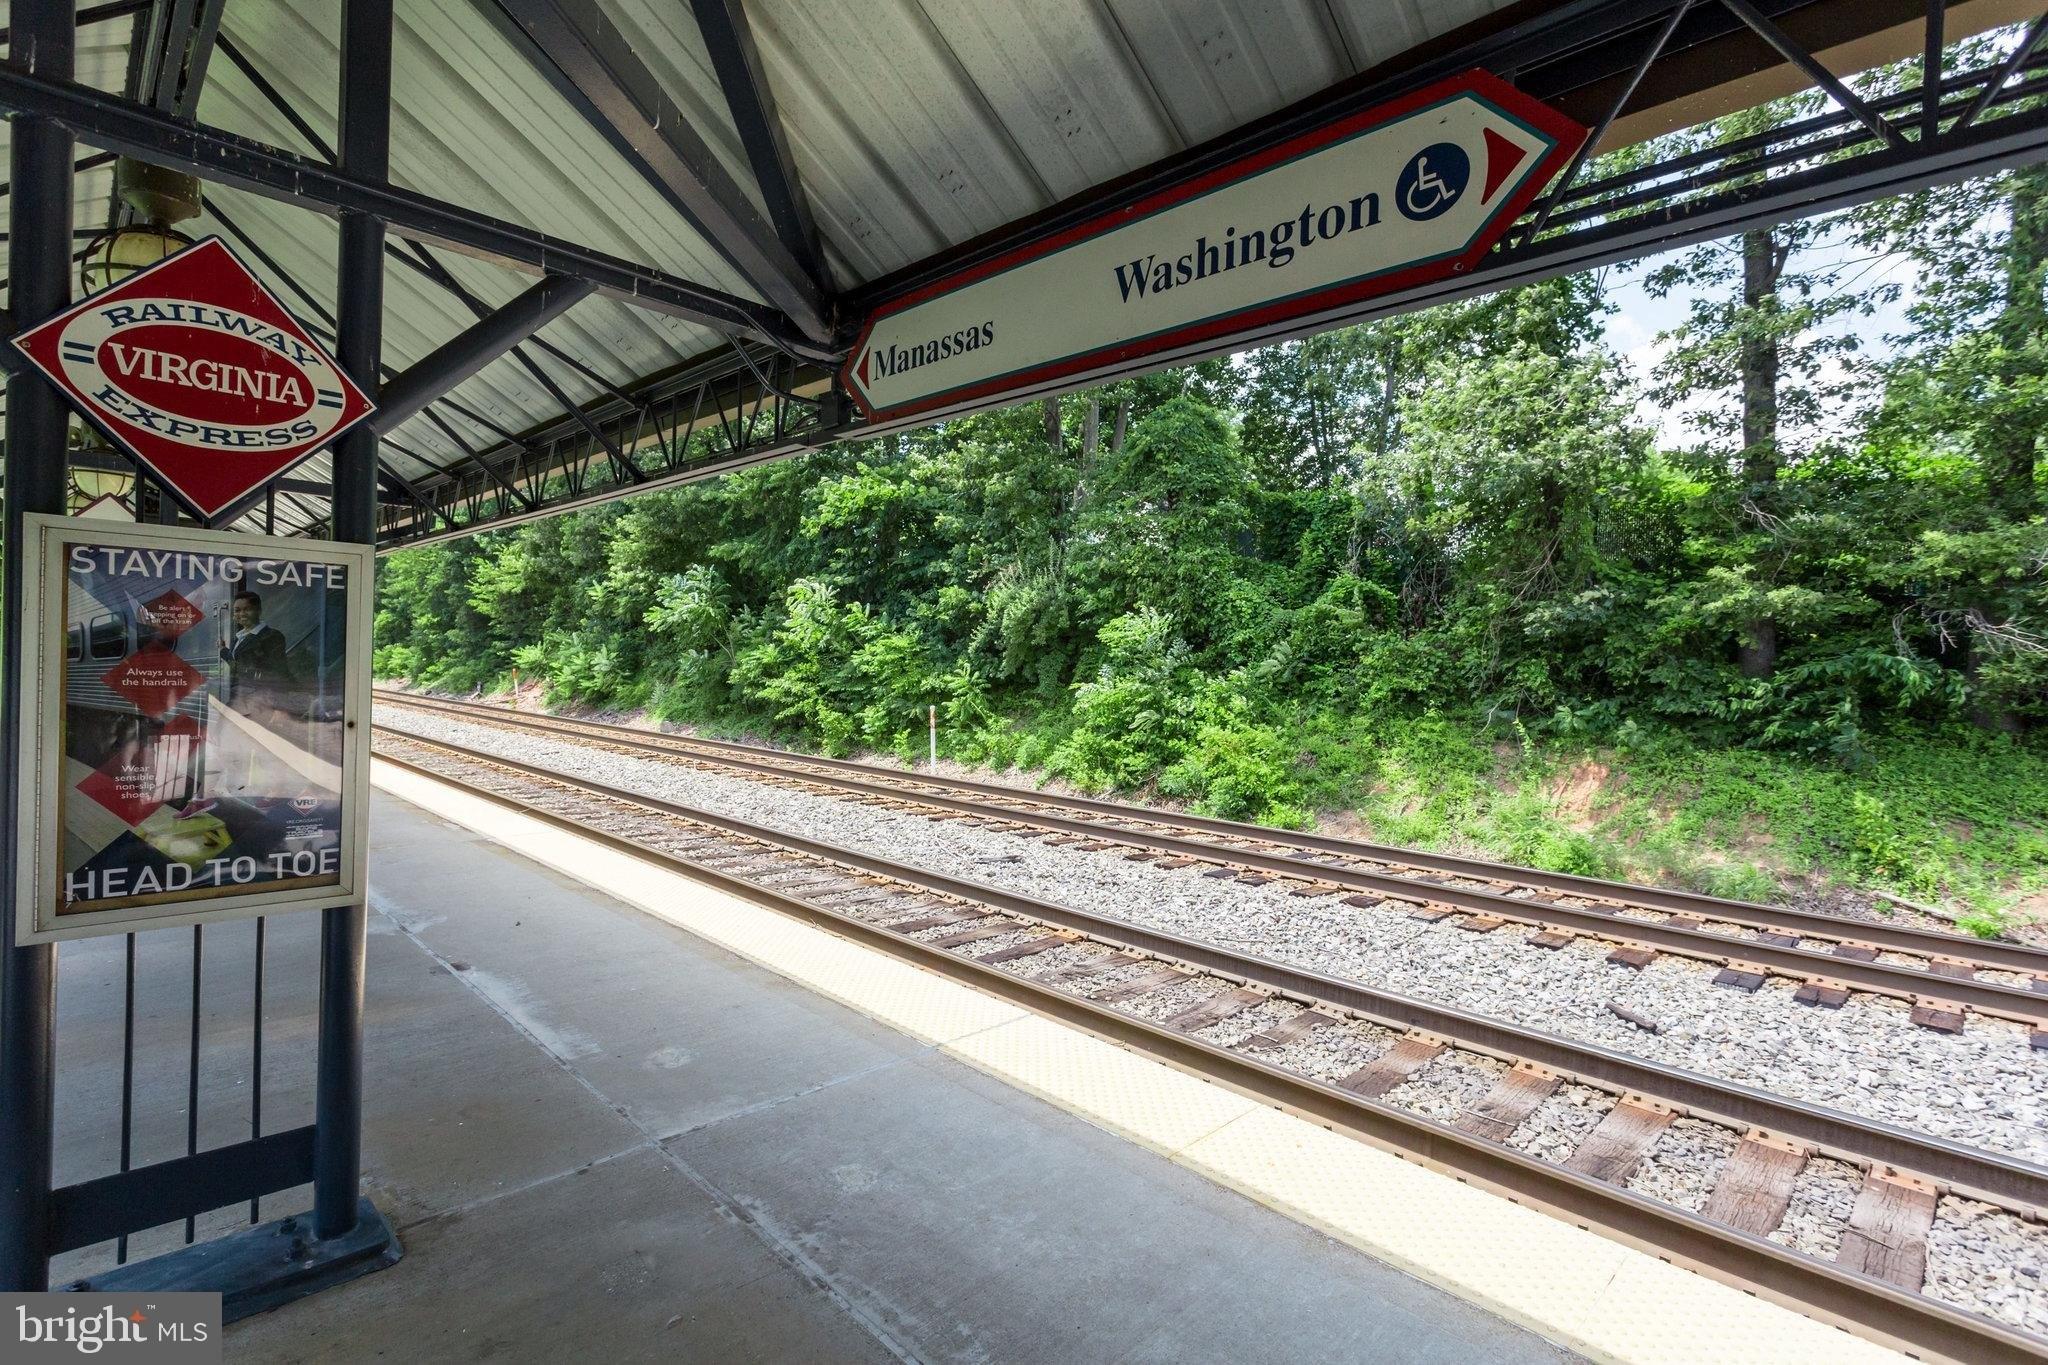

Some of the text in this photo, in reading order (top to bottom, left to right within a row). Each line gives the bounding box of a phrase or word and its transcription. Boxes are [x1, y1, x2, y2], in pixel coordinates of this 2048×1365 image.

[1114, 192, 1381, 304] Washington
[101, 303, 322, 368] RAILWAY
[872, 319, 995, 381] Manassas
[107, 342, 308, 407] VIRGINIA
[92, 384, 319, 447] EXPRESS
[70, 546, 346, 590] STAYING SAFE
[122, 678, 188, 687] the handrails
[126, 668, 184, 678] Always use
[114, 773, 155, 782] sensible
[115, 781, 156, 791] non-slip
[121, 764, 150, 773] Wear
[66, 848, 340, 902] HEAD TO TOE
